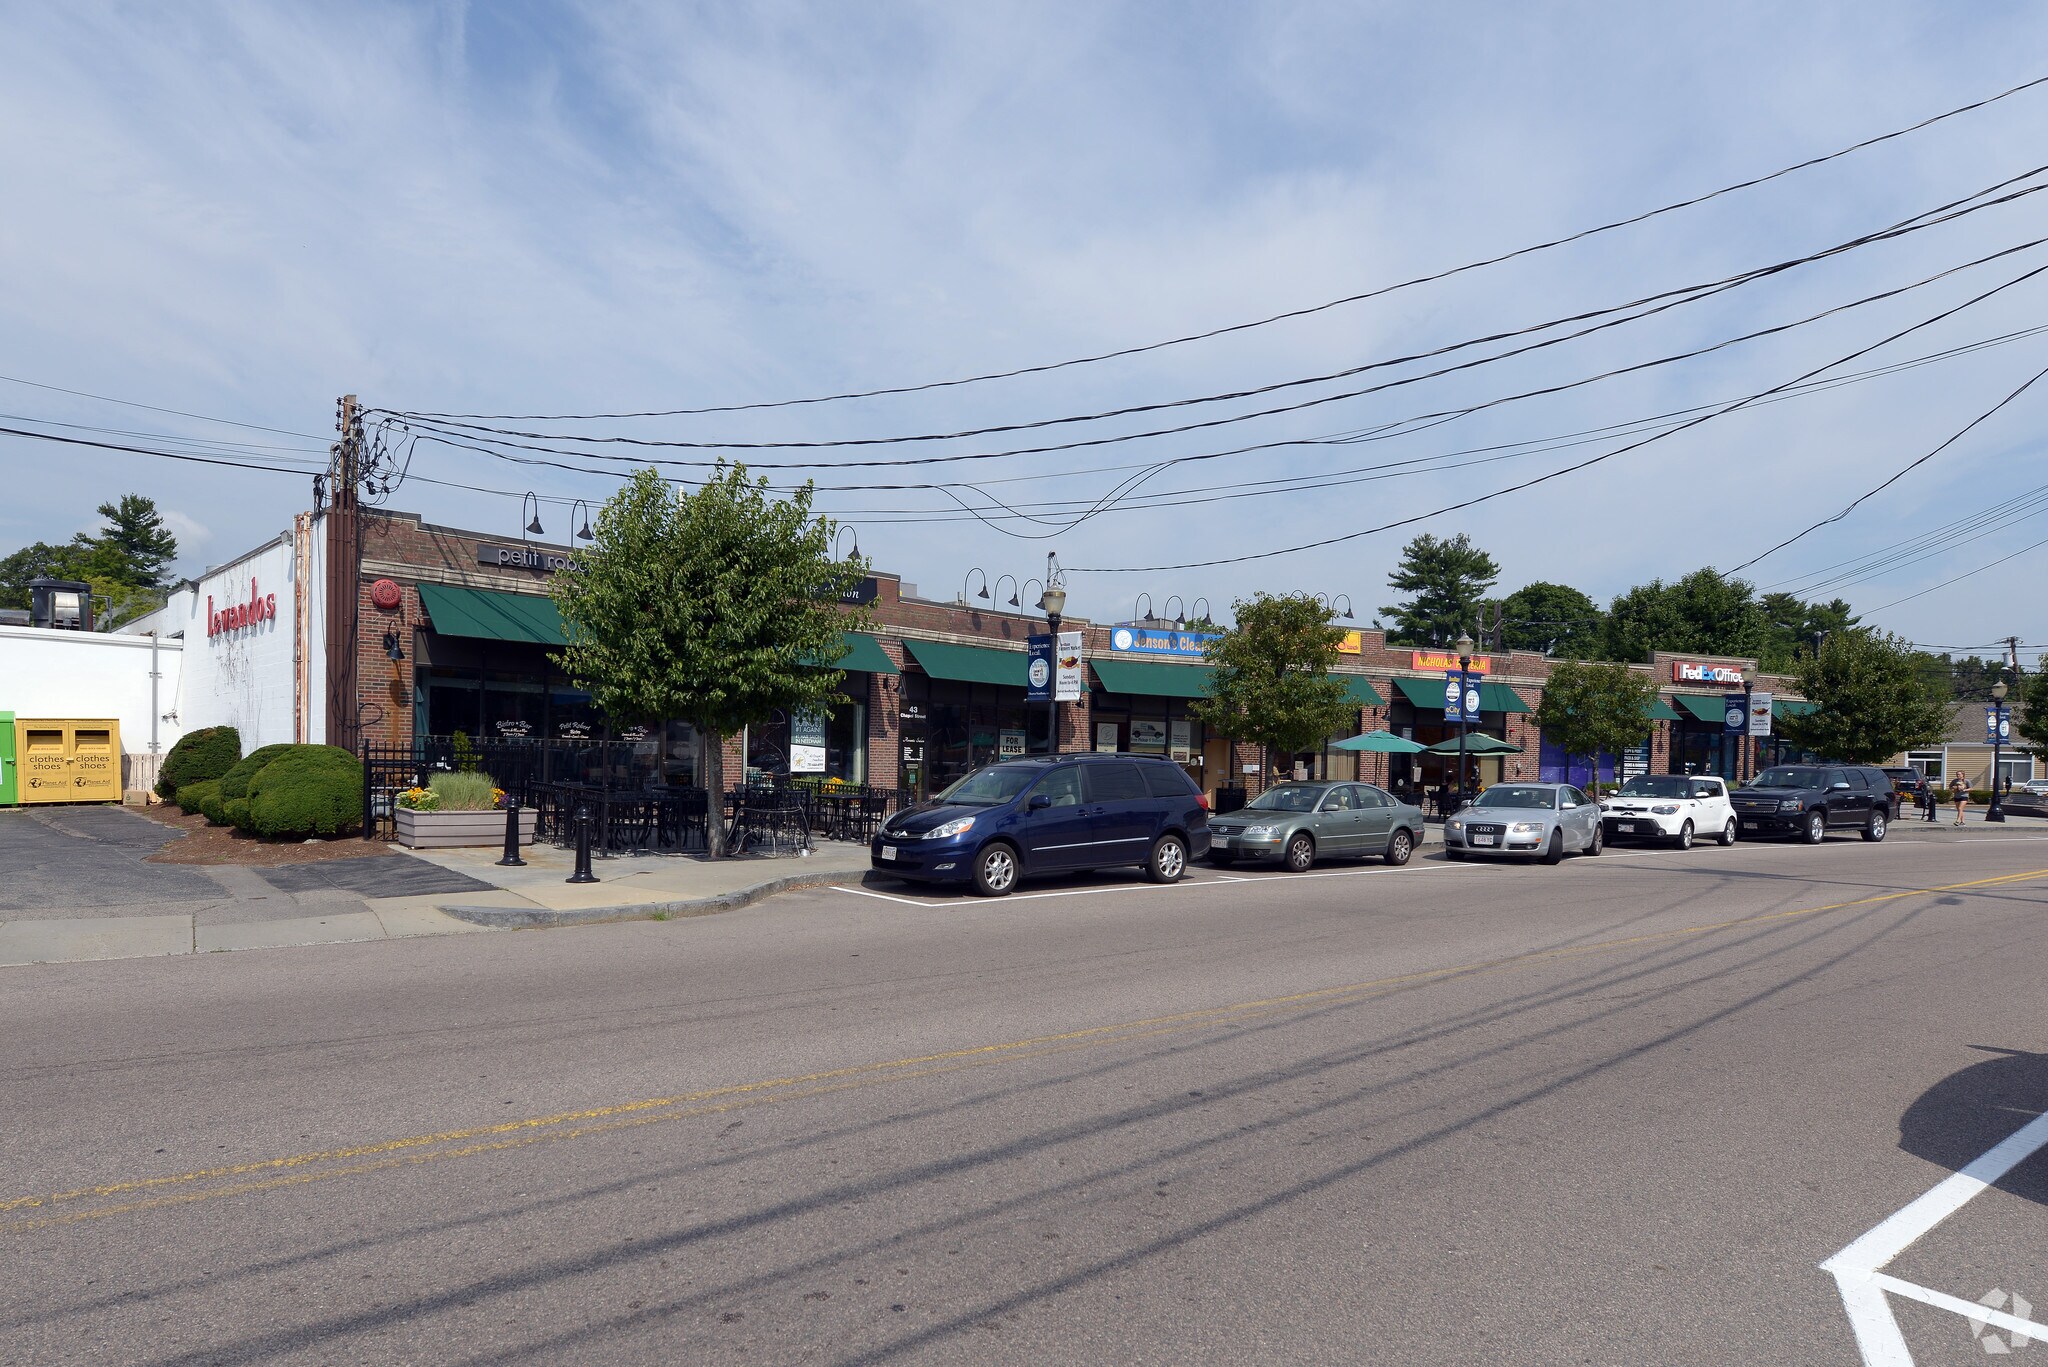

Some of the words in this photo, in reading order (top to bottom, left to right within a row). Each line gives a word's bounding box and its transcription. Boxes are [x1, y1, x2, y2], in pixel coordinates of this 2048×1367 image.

[498, 545, 539, 566] petit
[1133, 635, 1178, 651] Jenson's
[1418, 657, 1453, 668] NICHOLAS
[1455, 659, 1486, 671] PERIA
[1680, 664, 1715, 681] FedEx
[1715, 668, 1744, 683] Office
[496, 720, 515, 729] Bistro
[519, 721, 532, 729] Bar
[572, 721, 591, 730] Robert
[1006, 736, 1019, 745] FOR
[1002, 745, 1022, 753] LEASE
[29, 755, 65, 763] clothes
[76, 755, 110, 763] clothes
[79, 762, 107, 770] shoes
